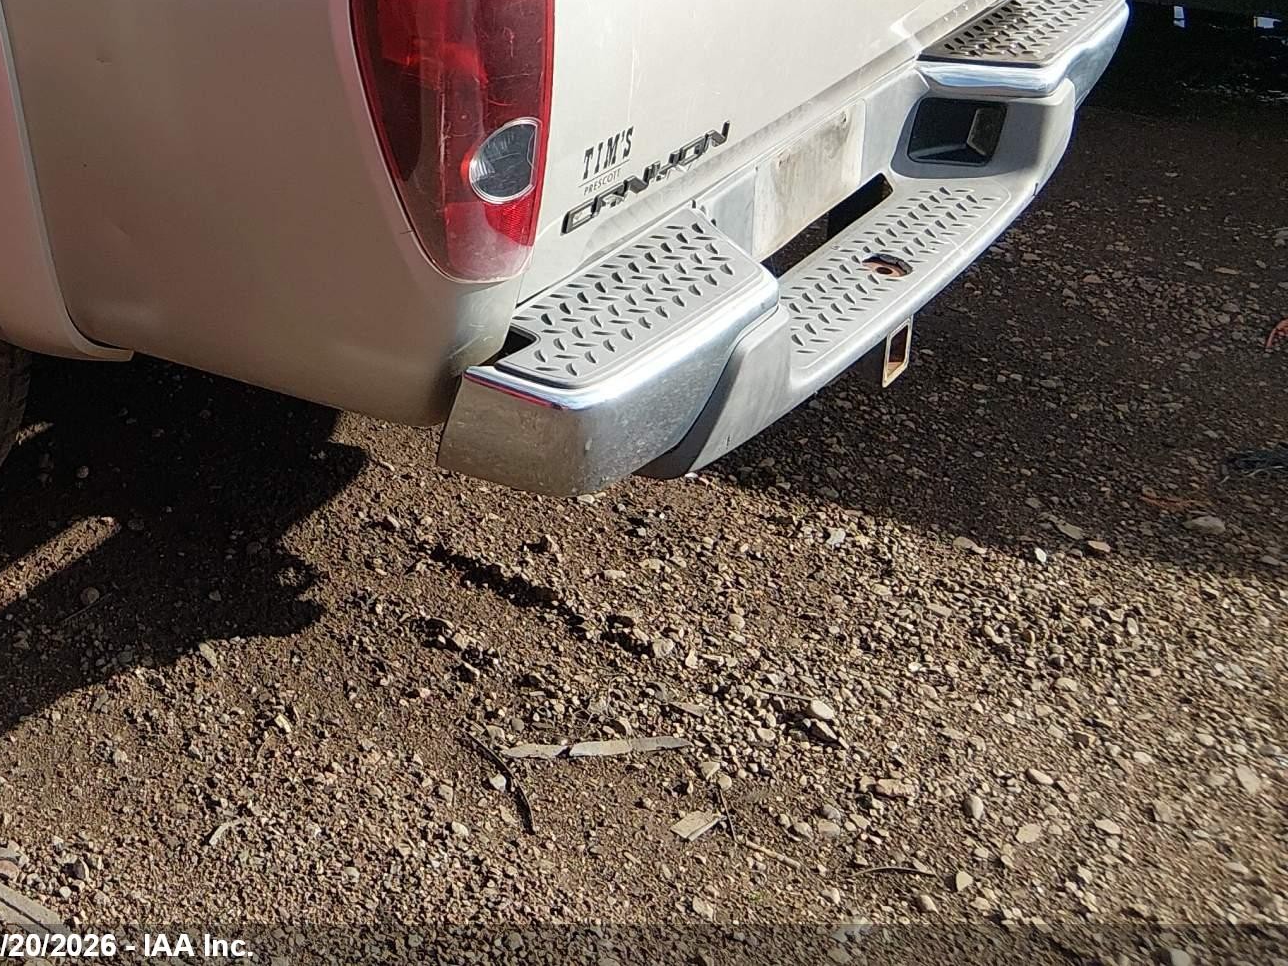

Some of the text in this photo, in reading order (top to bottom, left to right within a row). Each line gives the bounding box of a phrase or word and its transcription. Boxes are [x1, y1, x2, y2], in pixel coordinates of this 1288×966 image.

[560, 120, 730, 236] CANYON
[583, 126, 634, 180] TIM'S
[583, 167, 622, 196] PRESCOTT
